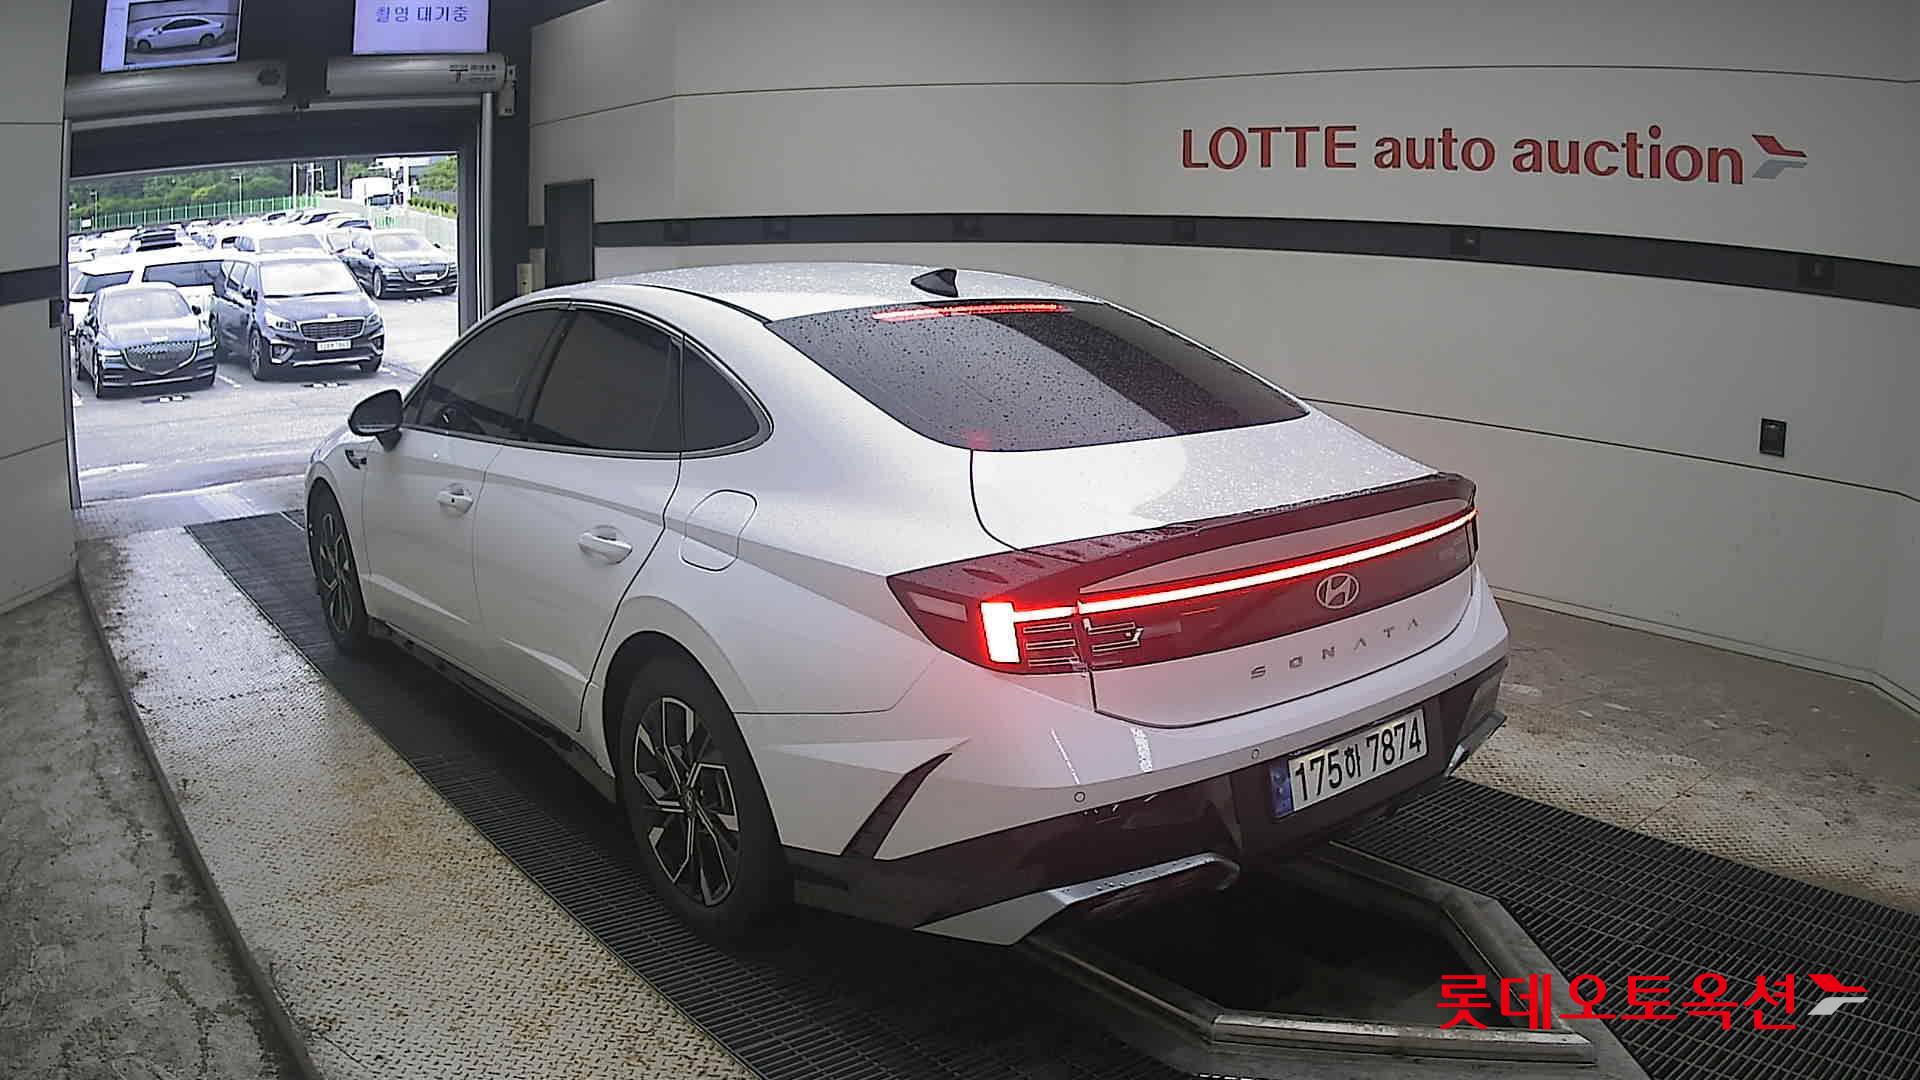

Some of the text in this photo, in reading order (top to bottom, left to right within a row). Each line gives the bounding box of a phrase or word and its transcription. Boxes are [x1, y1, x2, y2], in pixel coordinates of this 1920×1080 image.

[417, 5, 469, 23] 대기중
[1181, 124, 1744, 185] LOTTE auto auction
[1250, 617, 1419, 680] SONATA
[1295, 716, 1422, 801] 175하 7874
